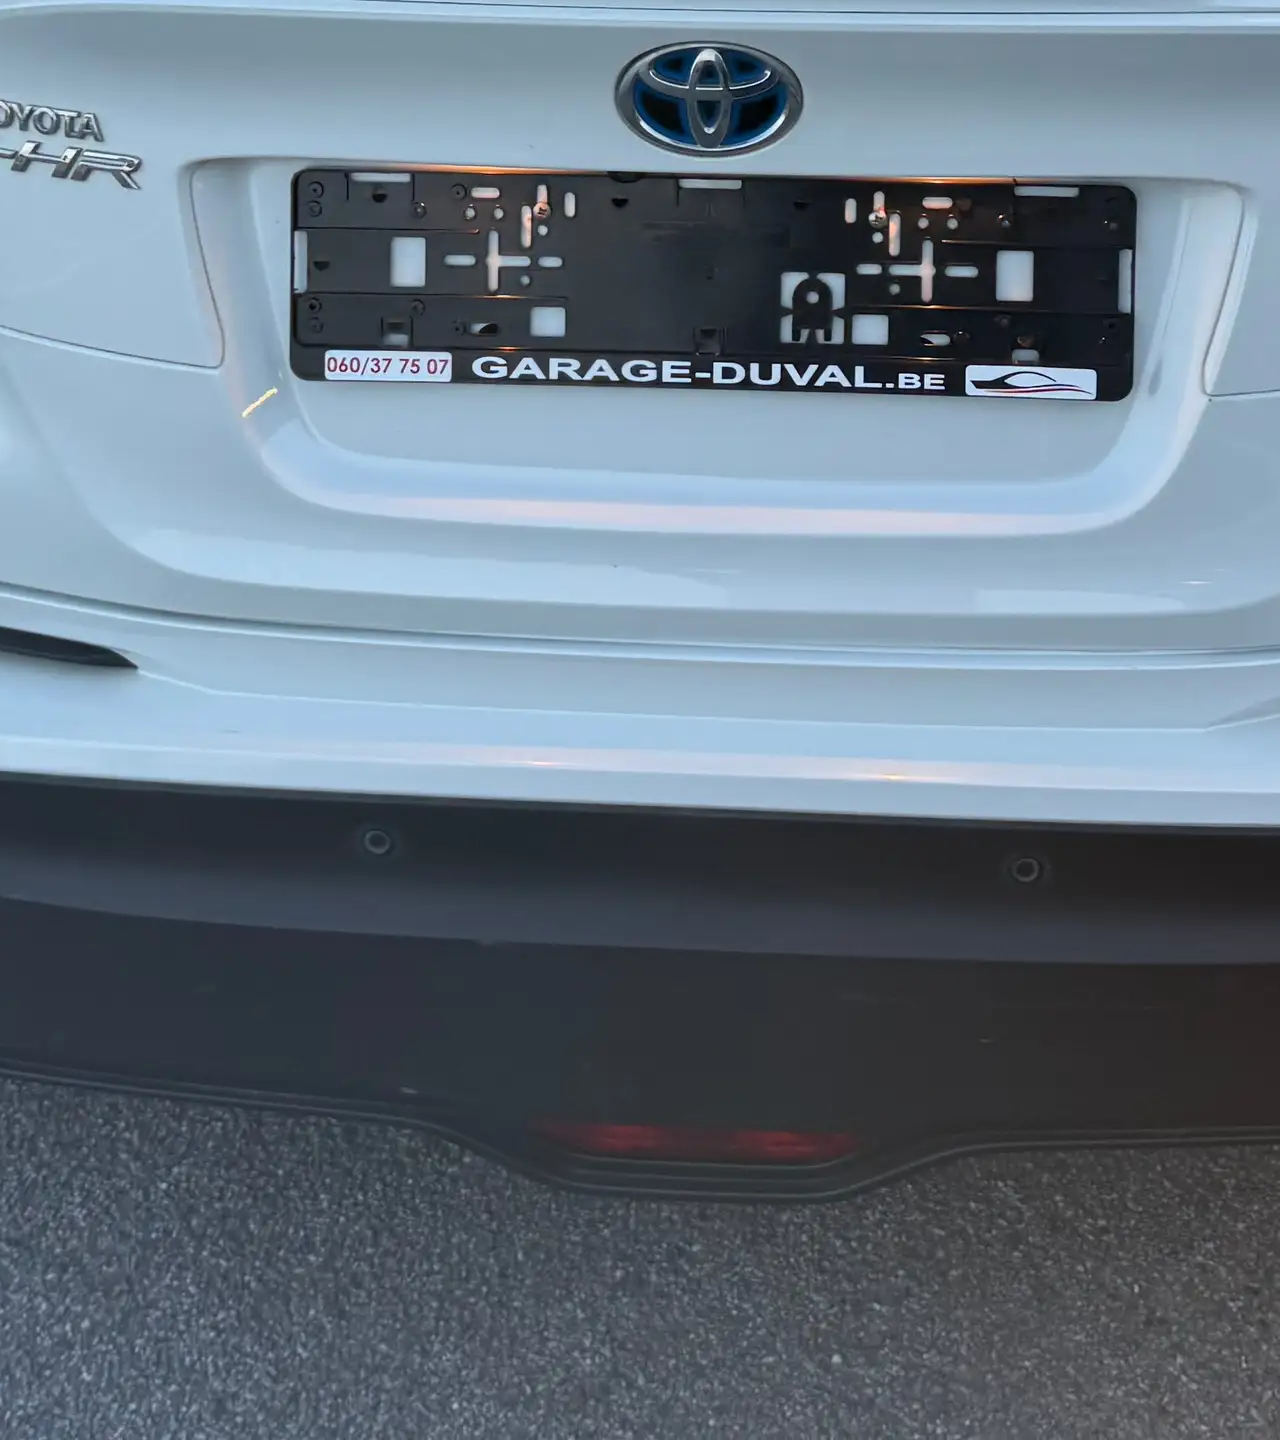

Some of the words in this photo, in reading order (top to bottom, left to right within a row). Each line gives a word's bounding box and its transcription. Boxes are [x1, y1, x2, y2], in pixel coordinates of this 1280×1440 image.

[327, 356, 393, 376] 060/37
[399, 357, 421, 375] 75
[427, 358, 449, 376] 07
[471, 355, 946, 391] GARAGE-DUVAL.BE
